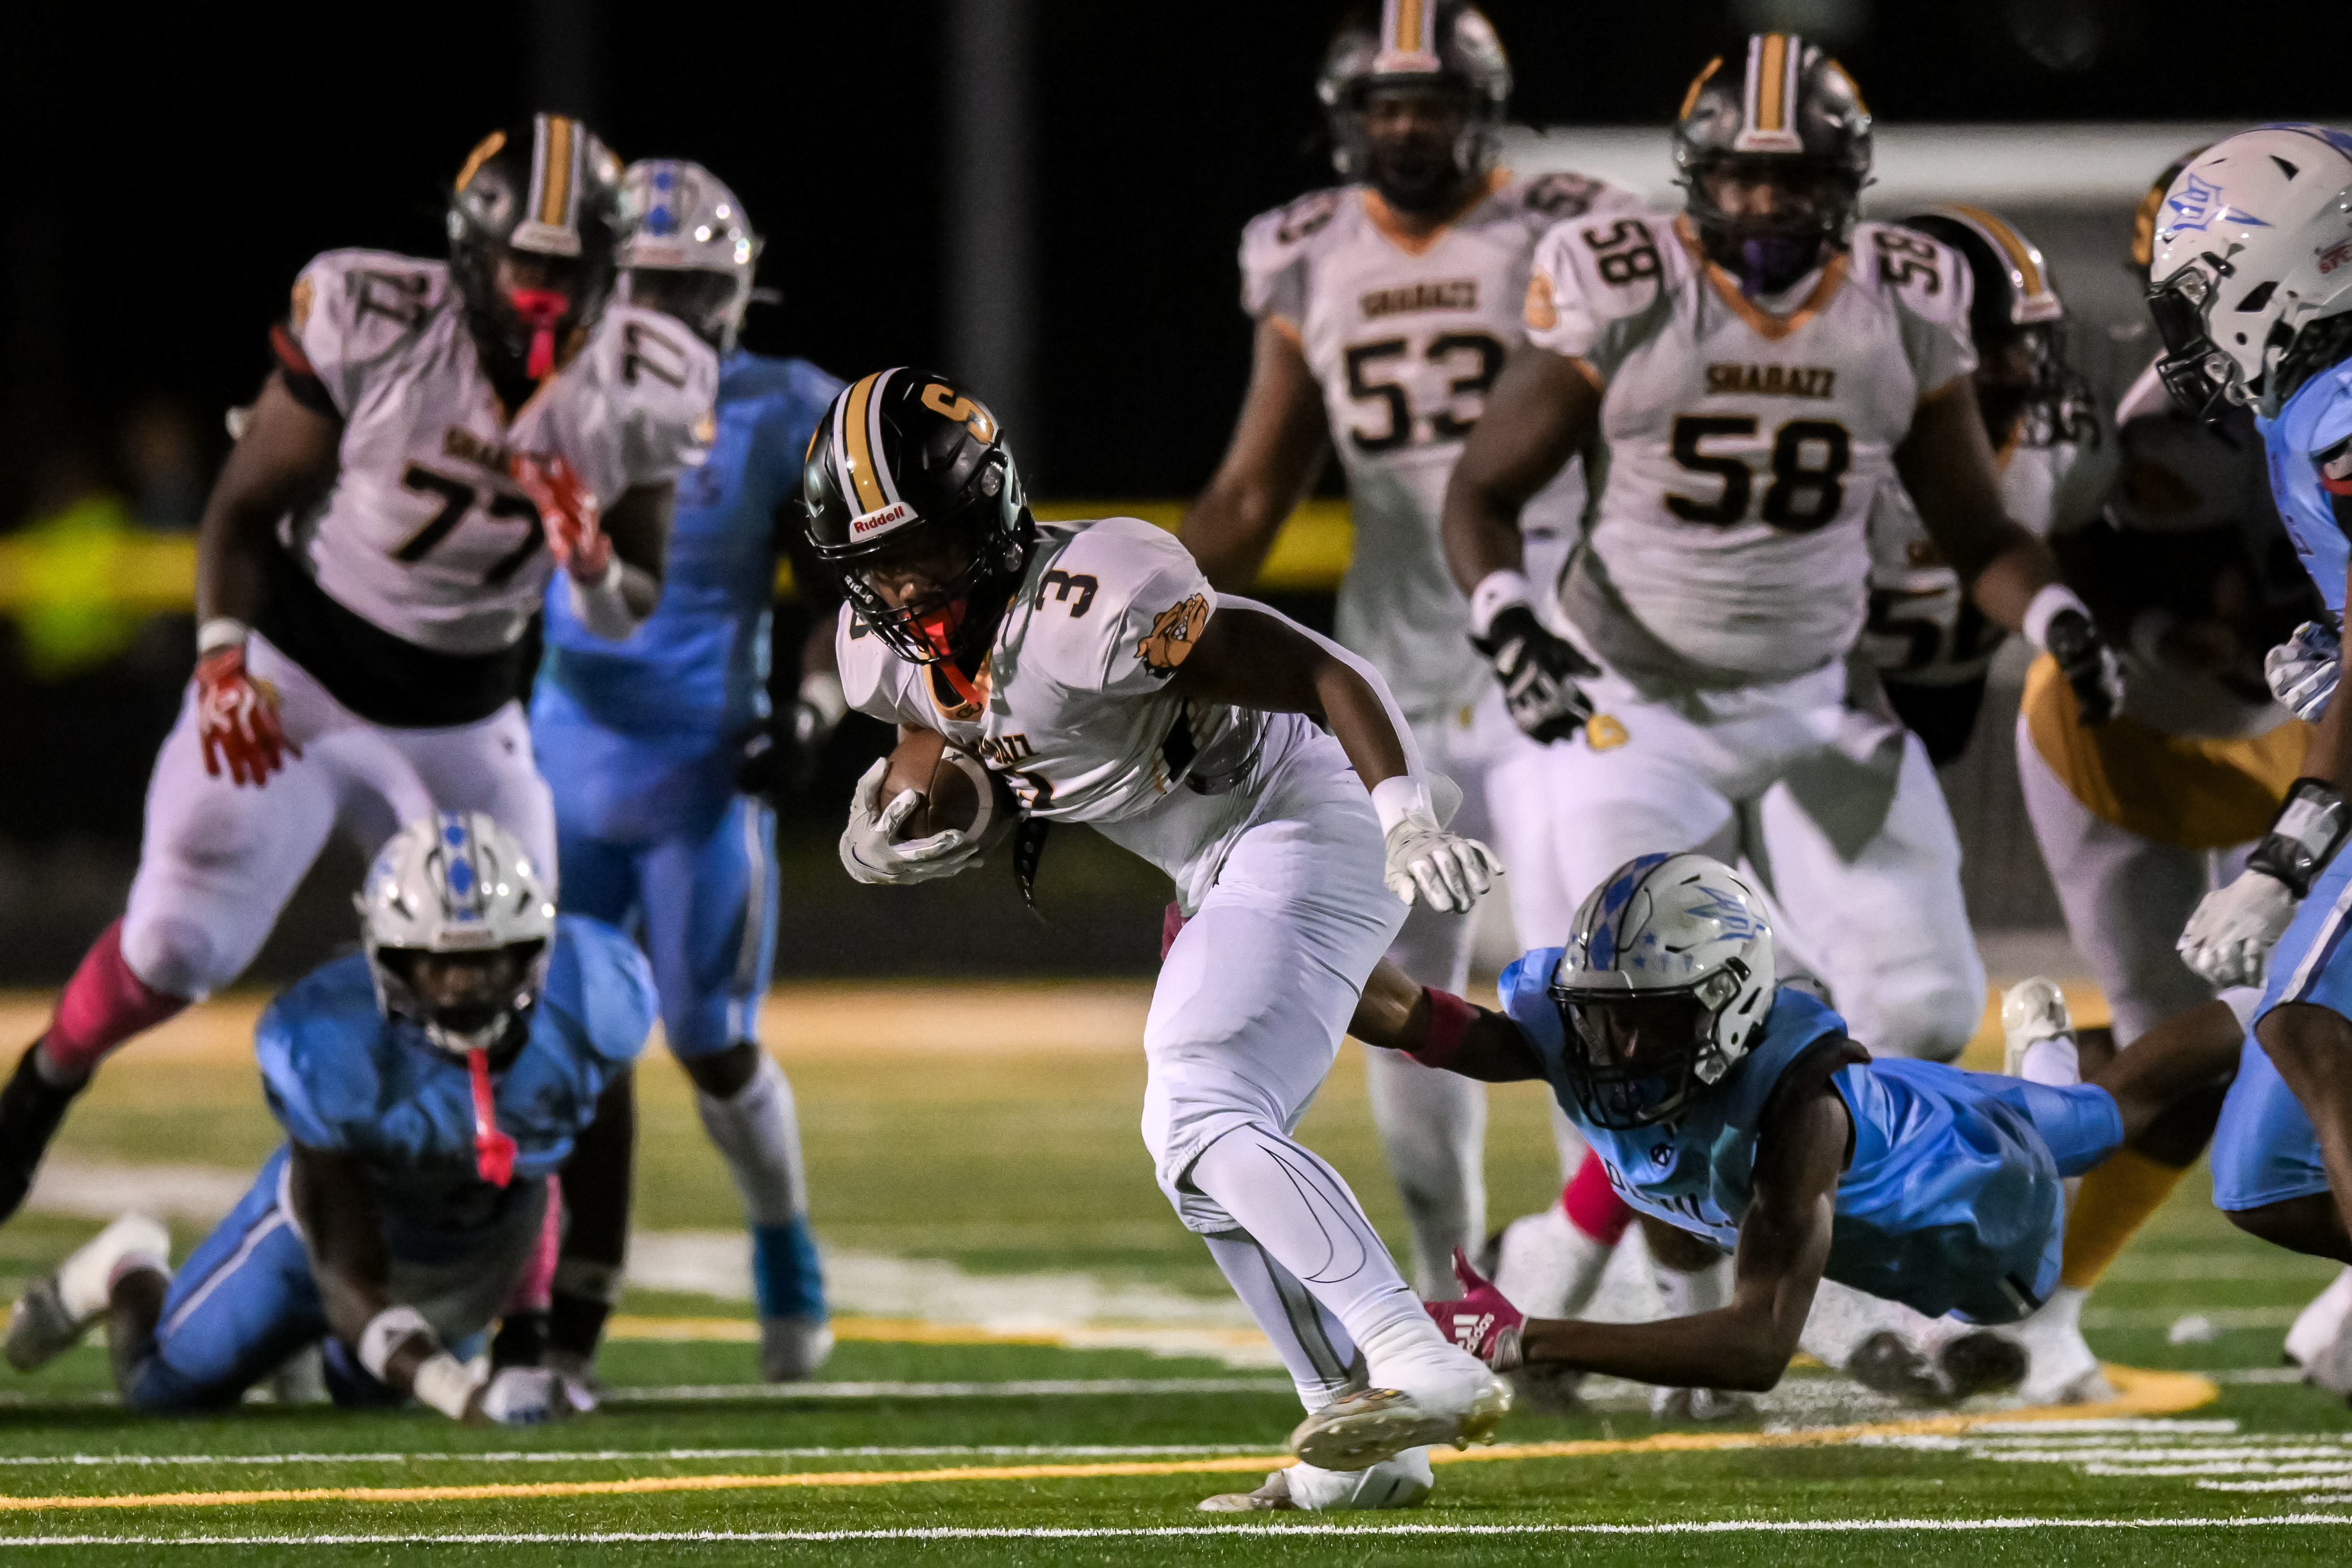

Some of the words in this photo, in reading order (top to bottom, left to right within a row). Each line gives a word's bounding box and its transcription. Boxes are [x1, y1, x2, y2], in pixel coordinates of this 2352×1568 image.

[1582, 219, 1663, 289] 58
[1873, 229, 1944, 296] 58
[621, 319, 687, 390] 77
[1704, 362, 1837, 399] SHABAZZ
[920, 382, 997, 446] S
[1344, 332, 1506, 452] 53
[1663, 414, 1851, 533] 58
[391, 460, 546, 584] 77
[854, 505, 905, 534] Riddell
[1034, 567, 1099, 619] 3
[1462, 1312, 1495, 1354] didas
